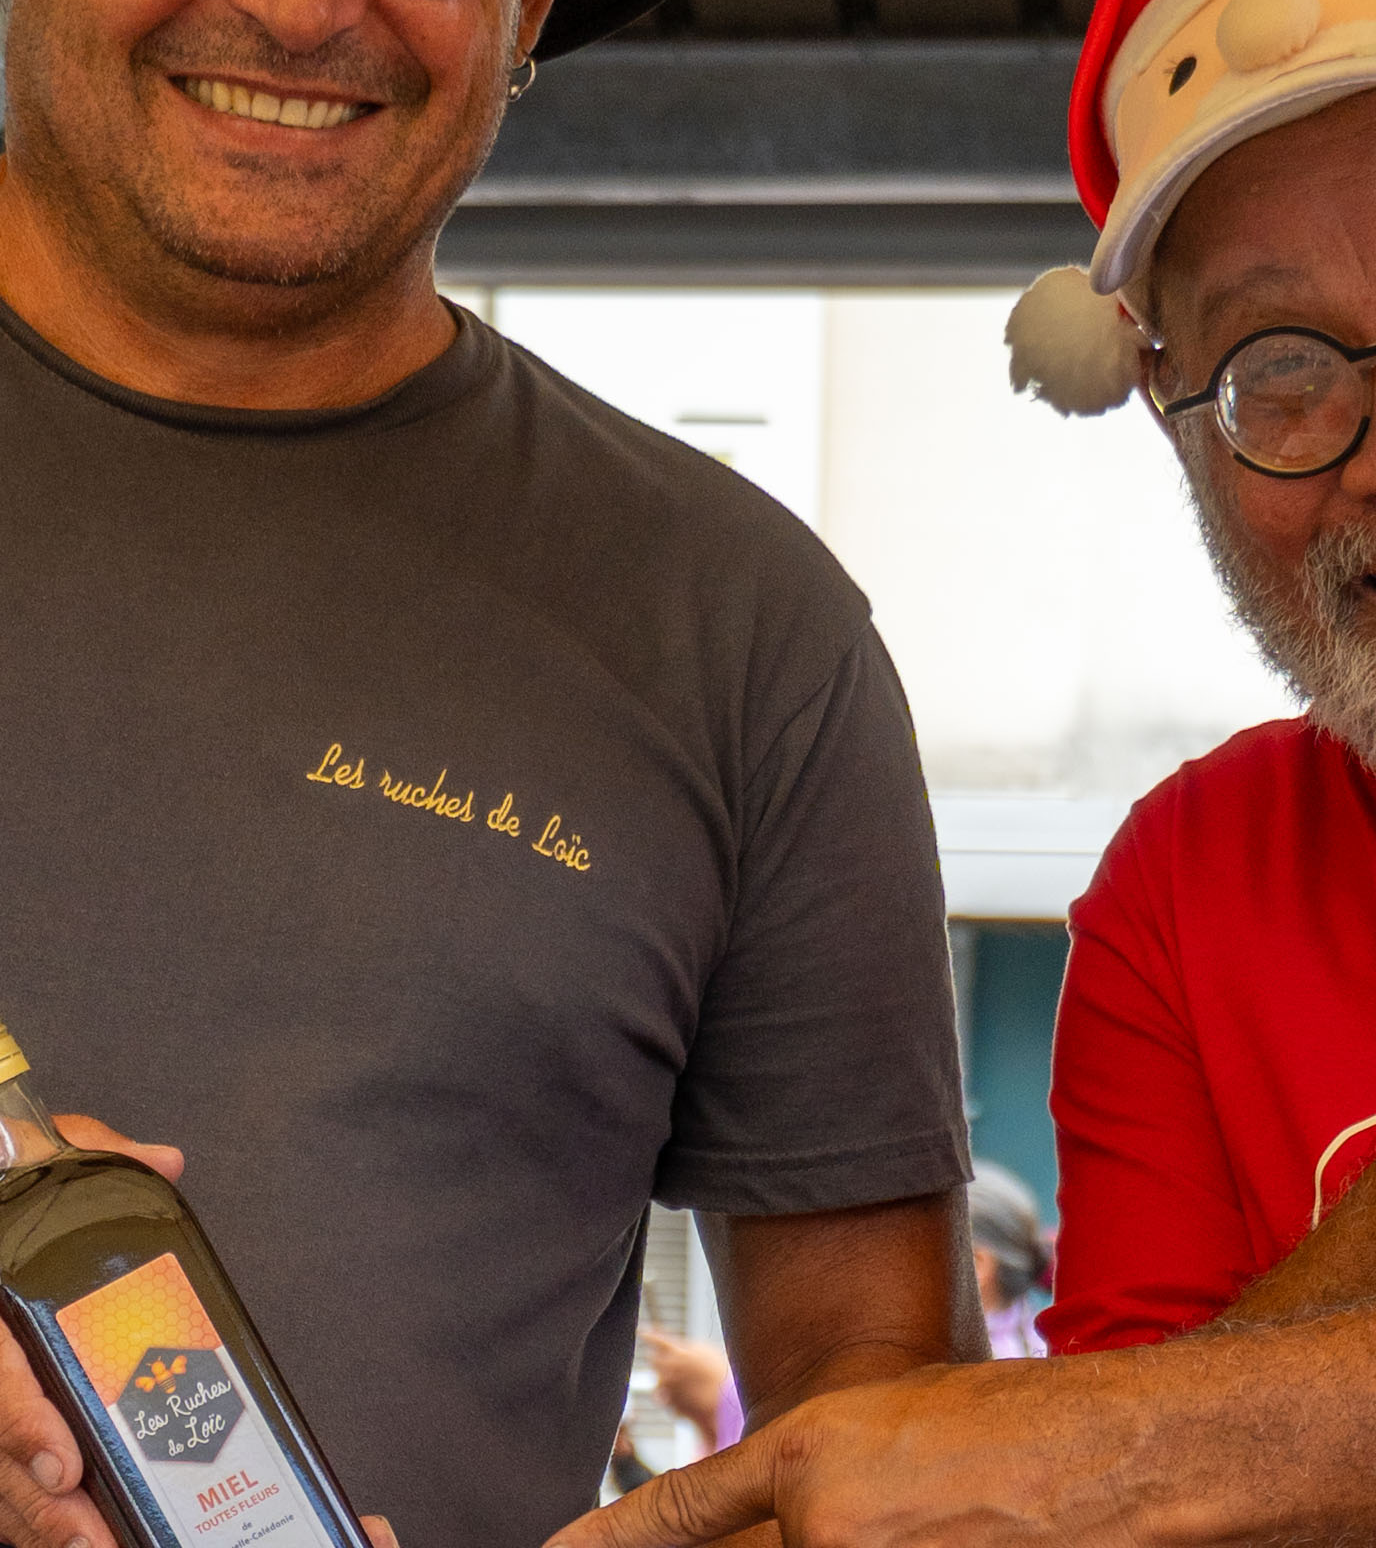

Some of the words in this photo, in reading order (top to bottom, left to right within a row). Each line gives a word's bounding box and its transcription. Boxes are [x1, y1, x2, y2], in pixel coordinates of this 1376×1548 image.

[307, 744, 365, 789] Les
[379, 768, 475, 822] ruches
[486, 793, 521, 838] de
[532, 814, 591, 871] Loïc
[134, 1410, 169, 1440] Les
[166, 1380, 232, 1418] Ruches
[168, 1439, 185, 1457] de
[184, 1413, 226, 1449] Loïc
[195, 1505, 238, 1535] TOUTES
[239, 1483, 281, 1512] FLEURS
[196, 1469, 259, 1513] MIEL
[242, 1521, 253, 1532] de
